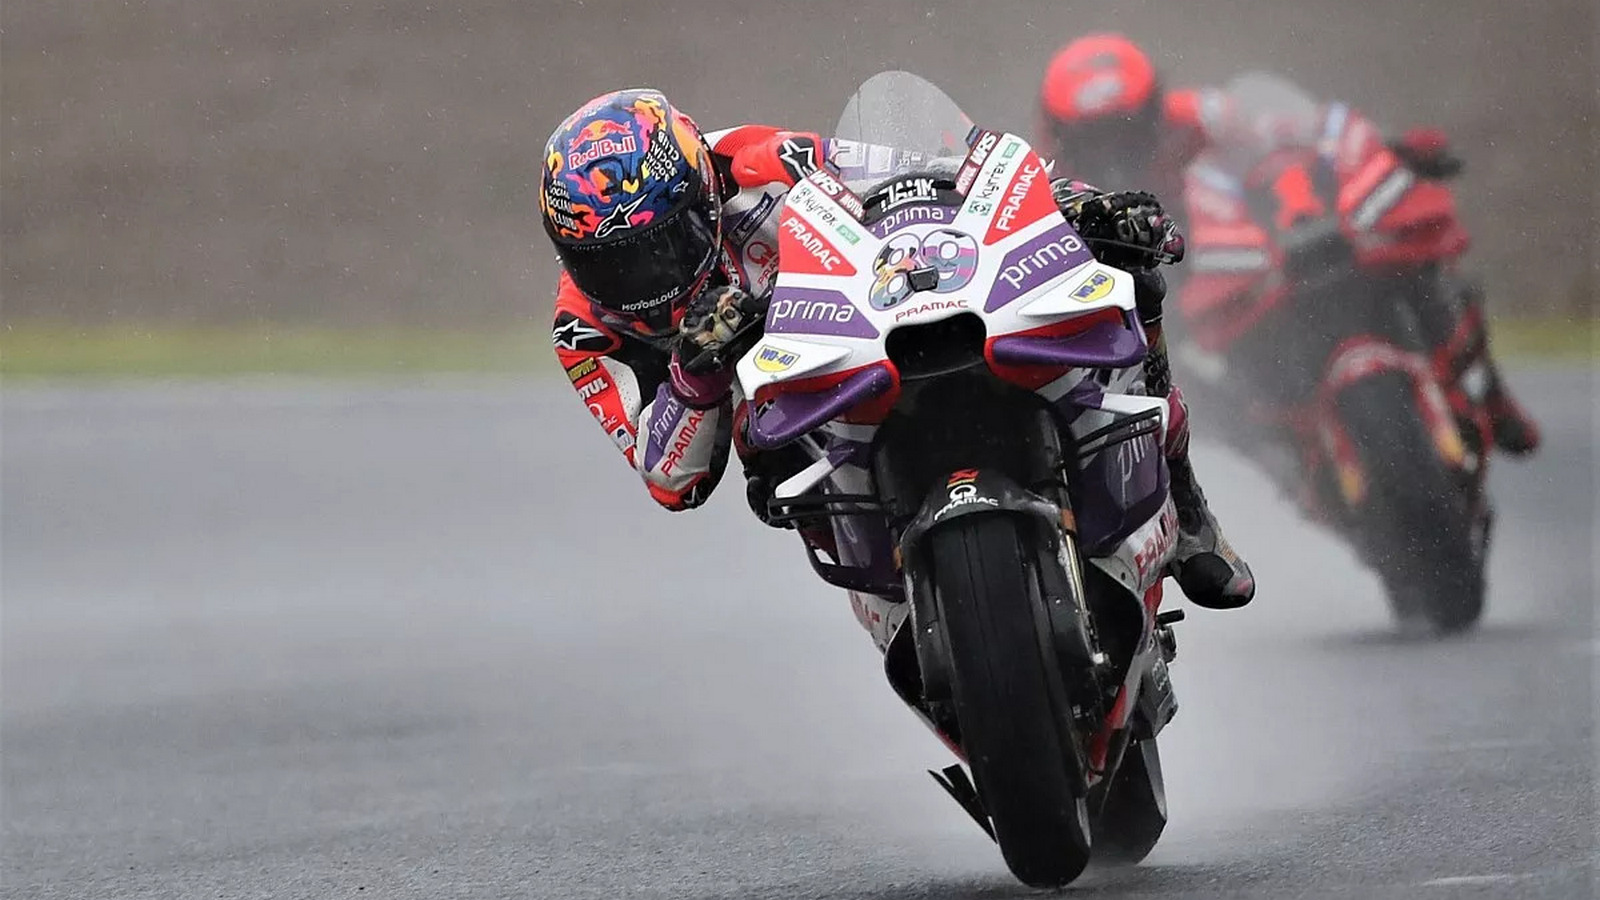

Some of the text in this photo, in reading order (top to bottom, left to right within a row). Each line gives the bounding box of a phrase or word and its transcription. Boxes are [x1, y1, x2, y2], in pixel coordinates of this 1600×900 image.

[569, 136, 637, 170] Red Bull
[658, 131, 679, 161] CLUB
[976, 161, 1008, 199] kyrrex
[802, 195, 837, 226] kyrrex
[995, 163, 1041, 231] PRAMAC
[880, 206, 944, 235] prima
[782, 215, 841, 272] PRAMAC
[868, 228, 979, 312] 89
[999, 234, 1082, 290] prima
[621, 286, 680, 311] MOTOBLOUZ
[1073, 273, 1108, 298] WD-40
[771, 299, 855, 328] prima
[895, 299, 969, 322] PRAMAC
[760, 347, 795, 366] WD-40
[934, 496, 999, 521] PRAMAC
